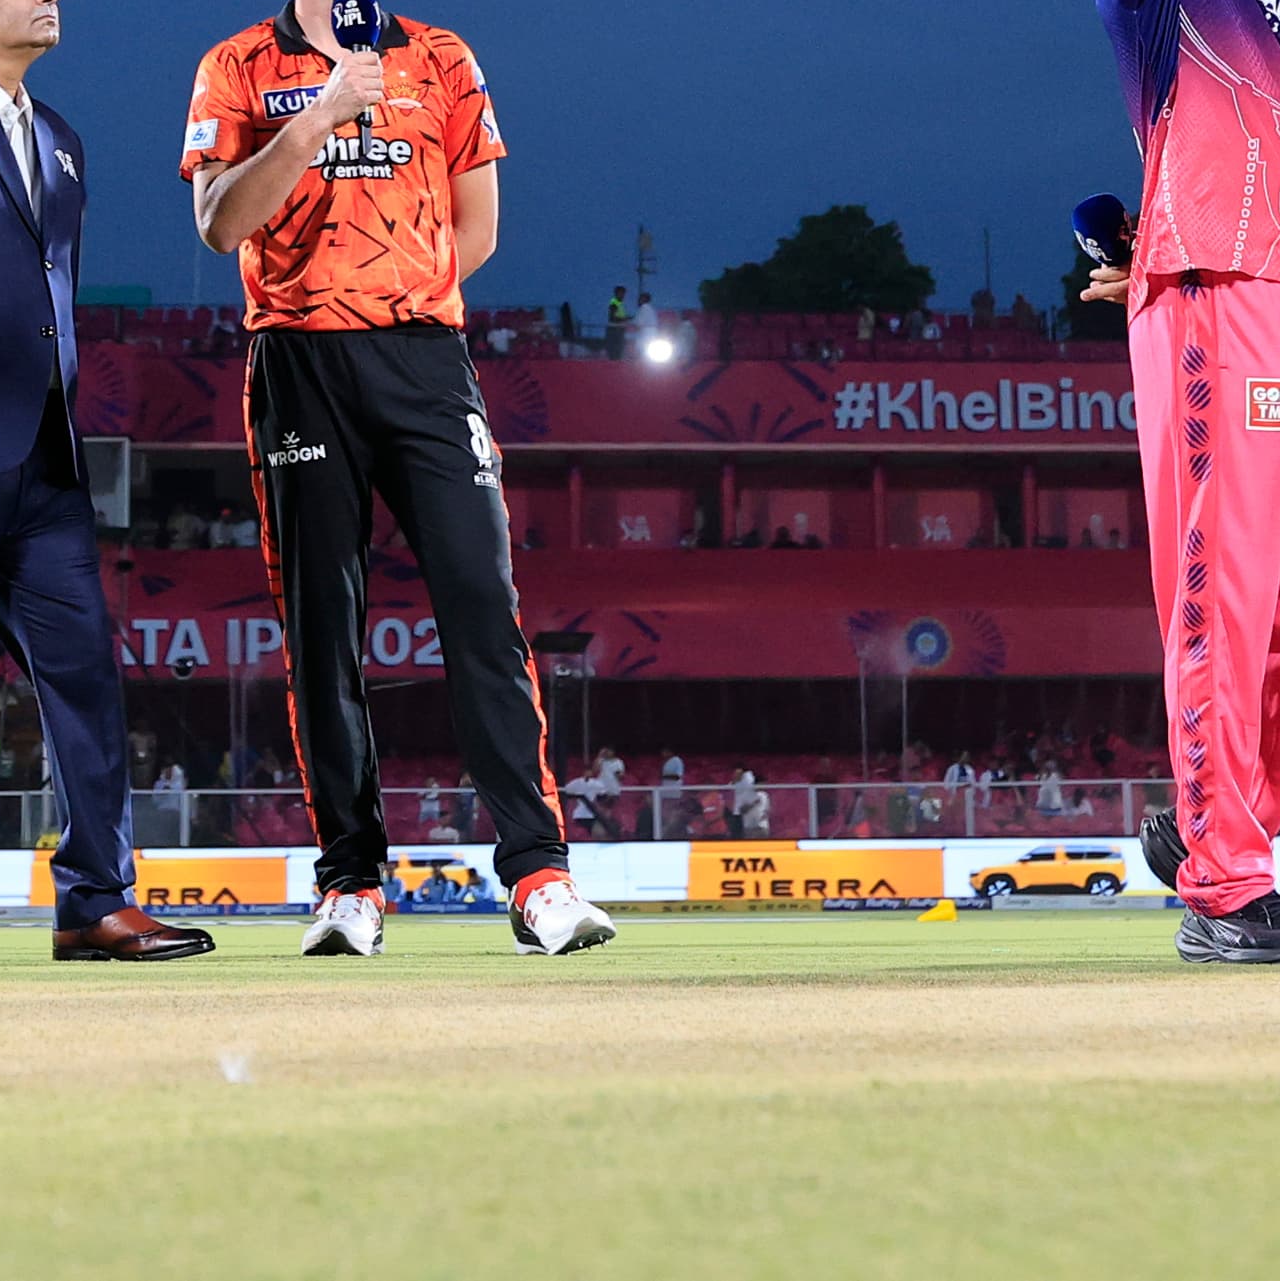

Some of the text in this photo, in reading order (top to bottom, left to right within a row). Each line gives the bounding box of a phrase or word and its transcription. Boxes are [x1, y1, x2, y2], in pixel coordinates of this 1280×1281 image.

[343, 12, 366, 27] IPL
[466, 413, 491, 459] 8
[267, 444, 327, 468] WROGN
[722, 858, 776, 872] TATA
[721, 880, 896, 897] SIERRA
